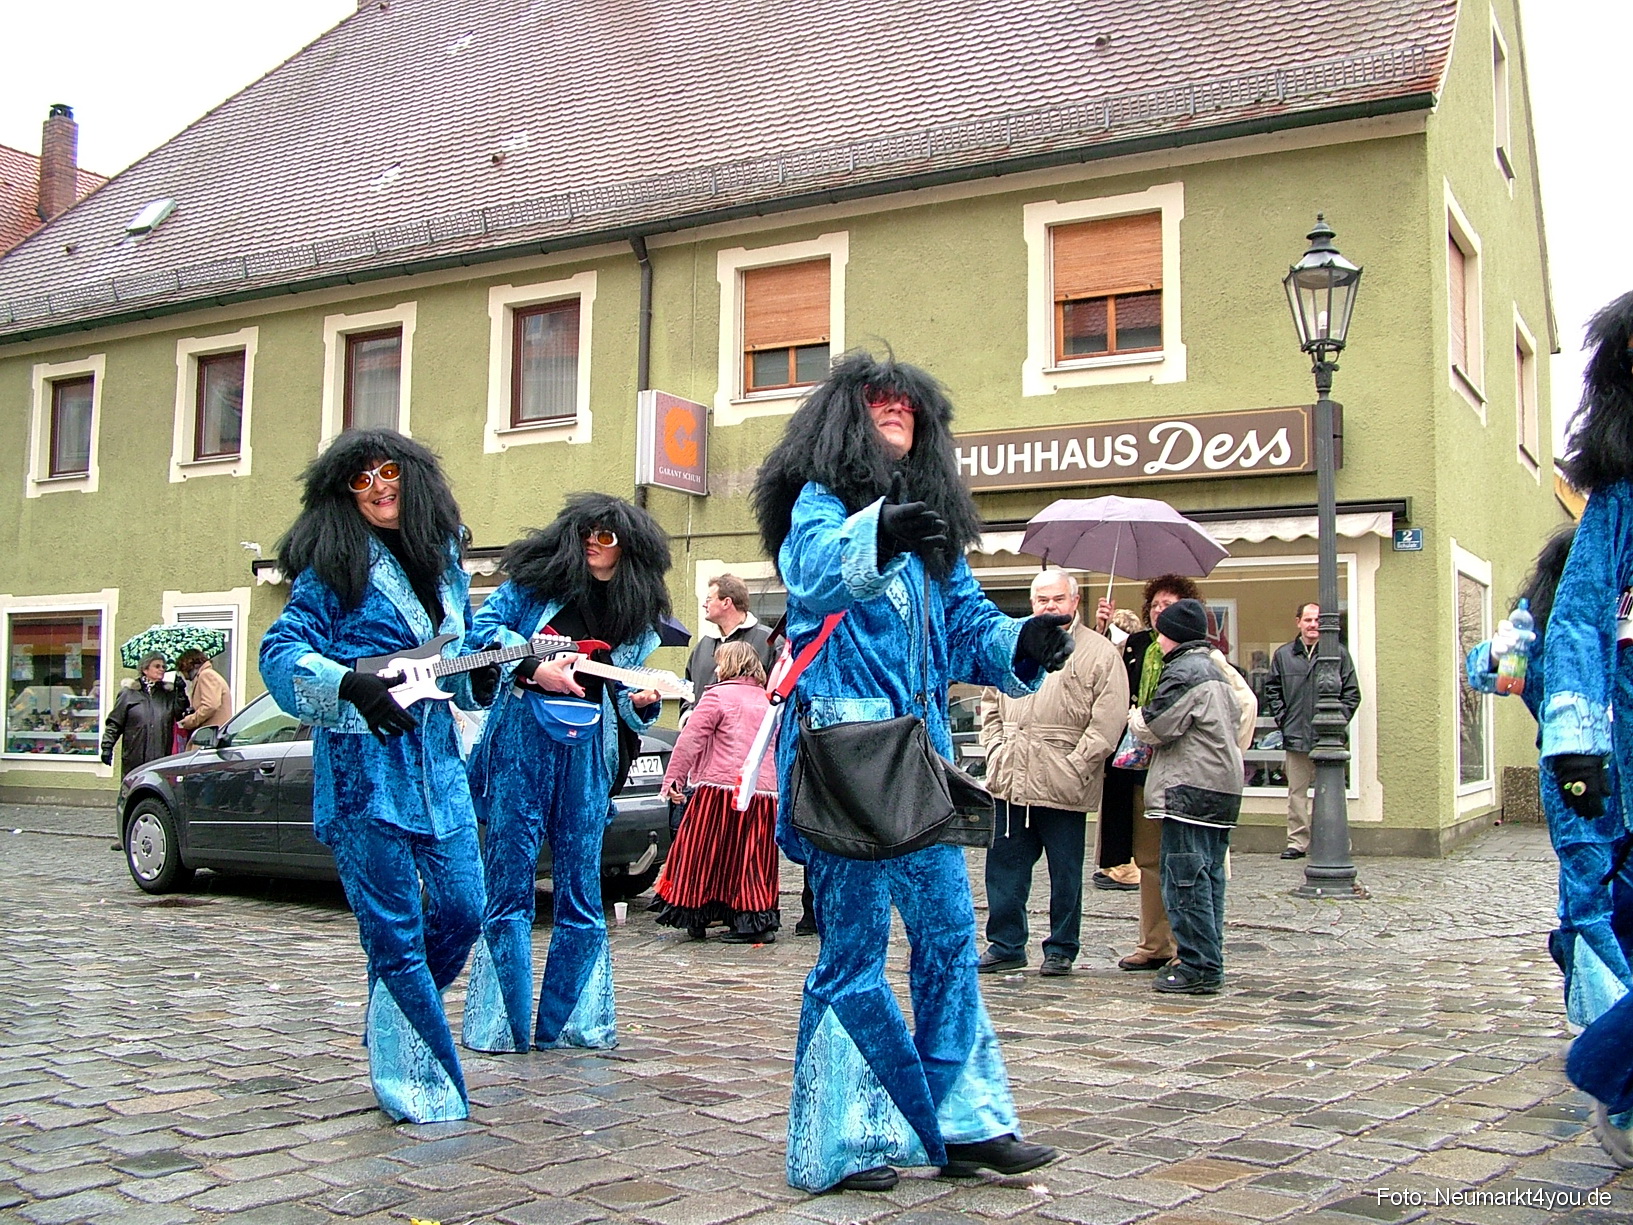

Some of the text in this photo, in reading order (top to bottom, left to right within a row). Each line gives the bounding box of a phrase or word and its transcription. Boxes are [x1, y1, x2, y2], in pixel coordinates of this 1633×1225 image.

[955, 421, 1292, 476] HUHHAUS Dess
[659, 466, 701, 483] GARANT SCHUH
[1402, 529, 1413, 541] 2
[640, 758, 659, 773] 127
